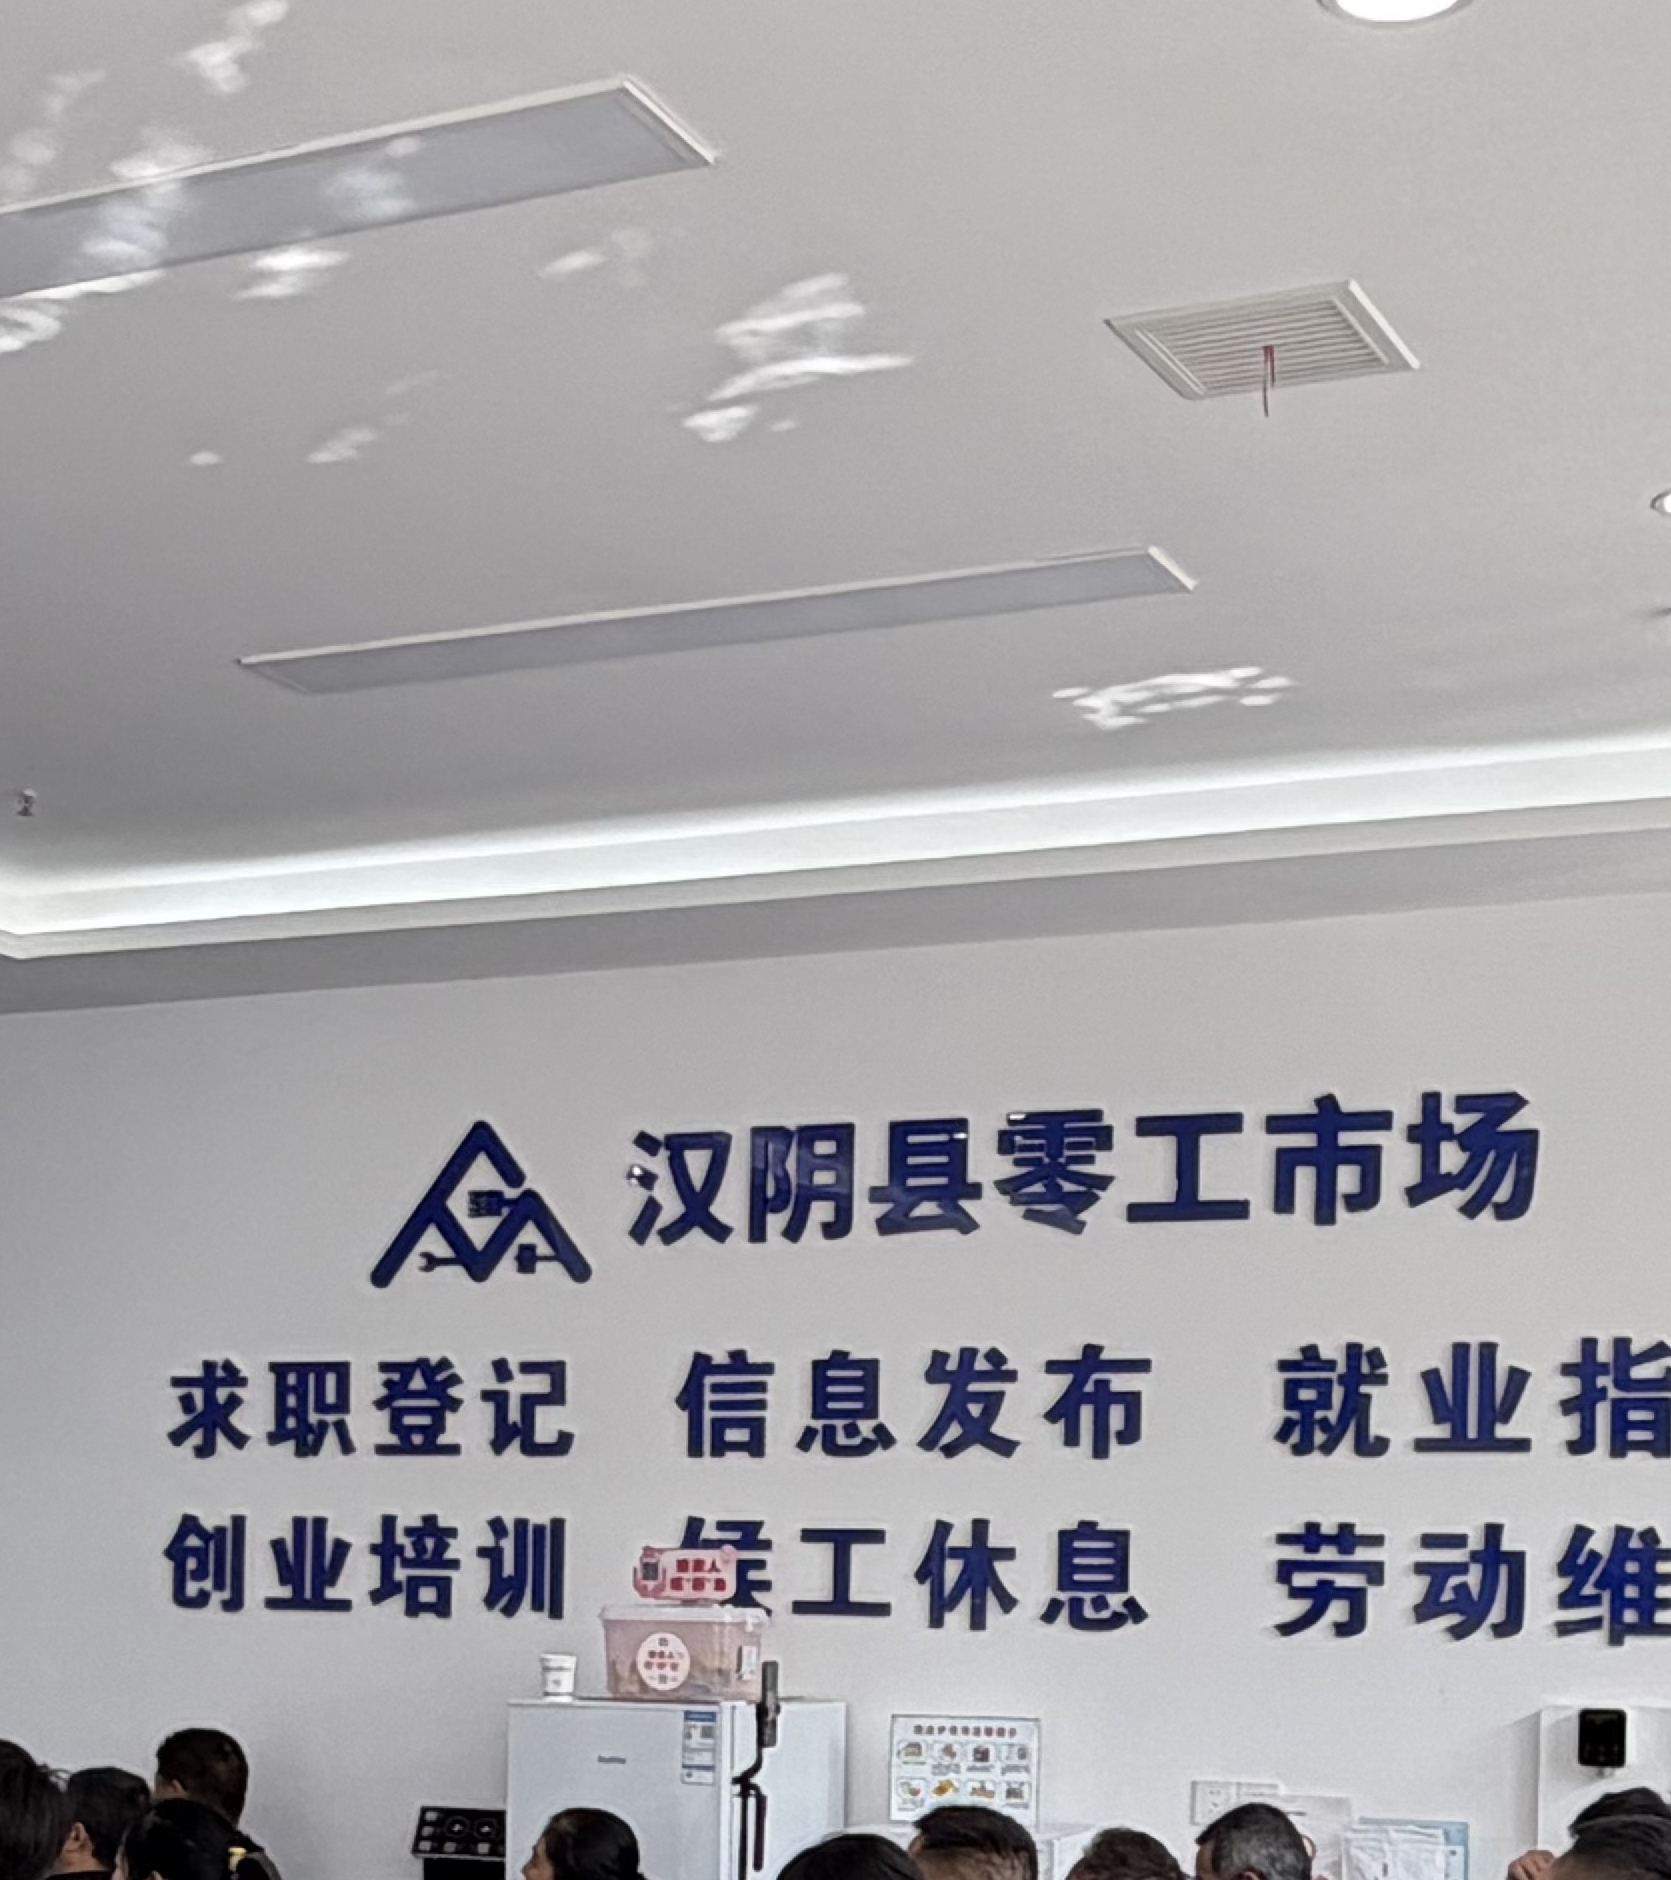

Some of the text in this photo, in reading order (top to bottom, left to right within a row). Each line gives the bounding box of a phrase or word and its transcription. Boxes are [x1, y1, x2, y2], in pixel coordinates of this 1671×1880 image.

[627, 1090, 1540, 1247] 汉阴县零工市场
[167, 1356, 574, 1460] 求职登记
[675, 1343, 1153, 1461] 信息发布
[163, 1513, 566, 1620] 创业培训
[678, 1515, 1149, 1631] 候工休息
